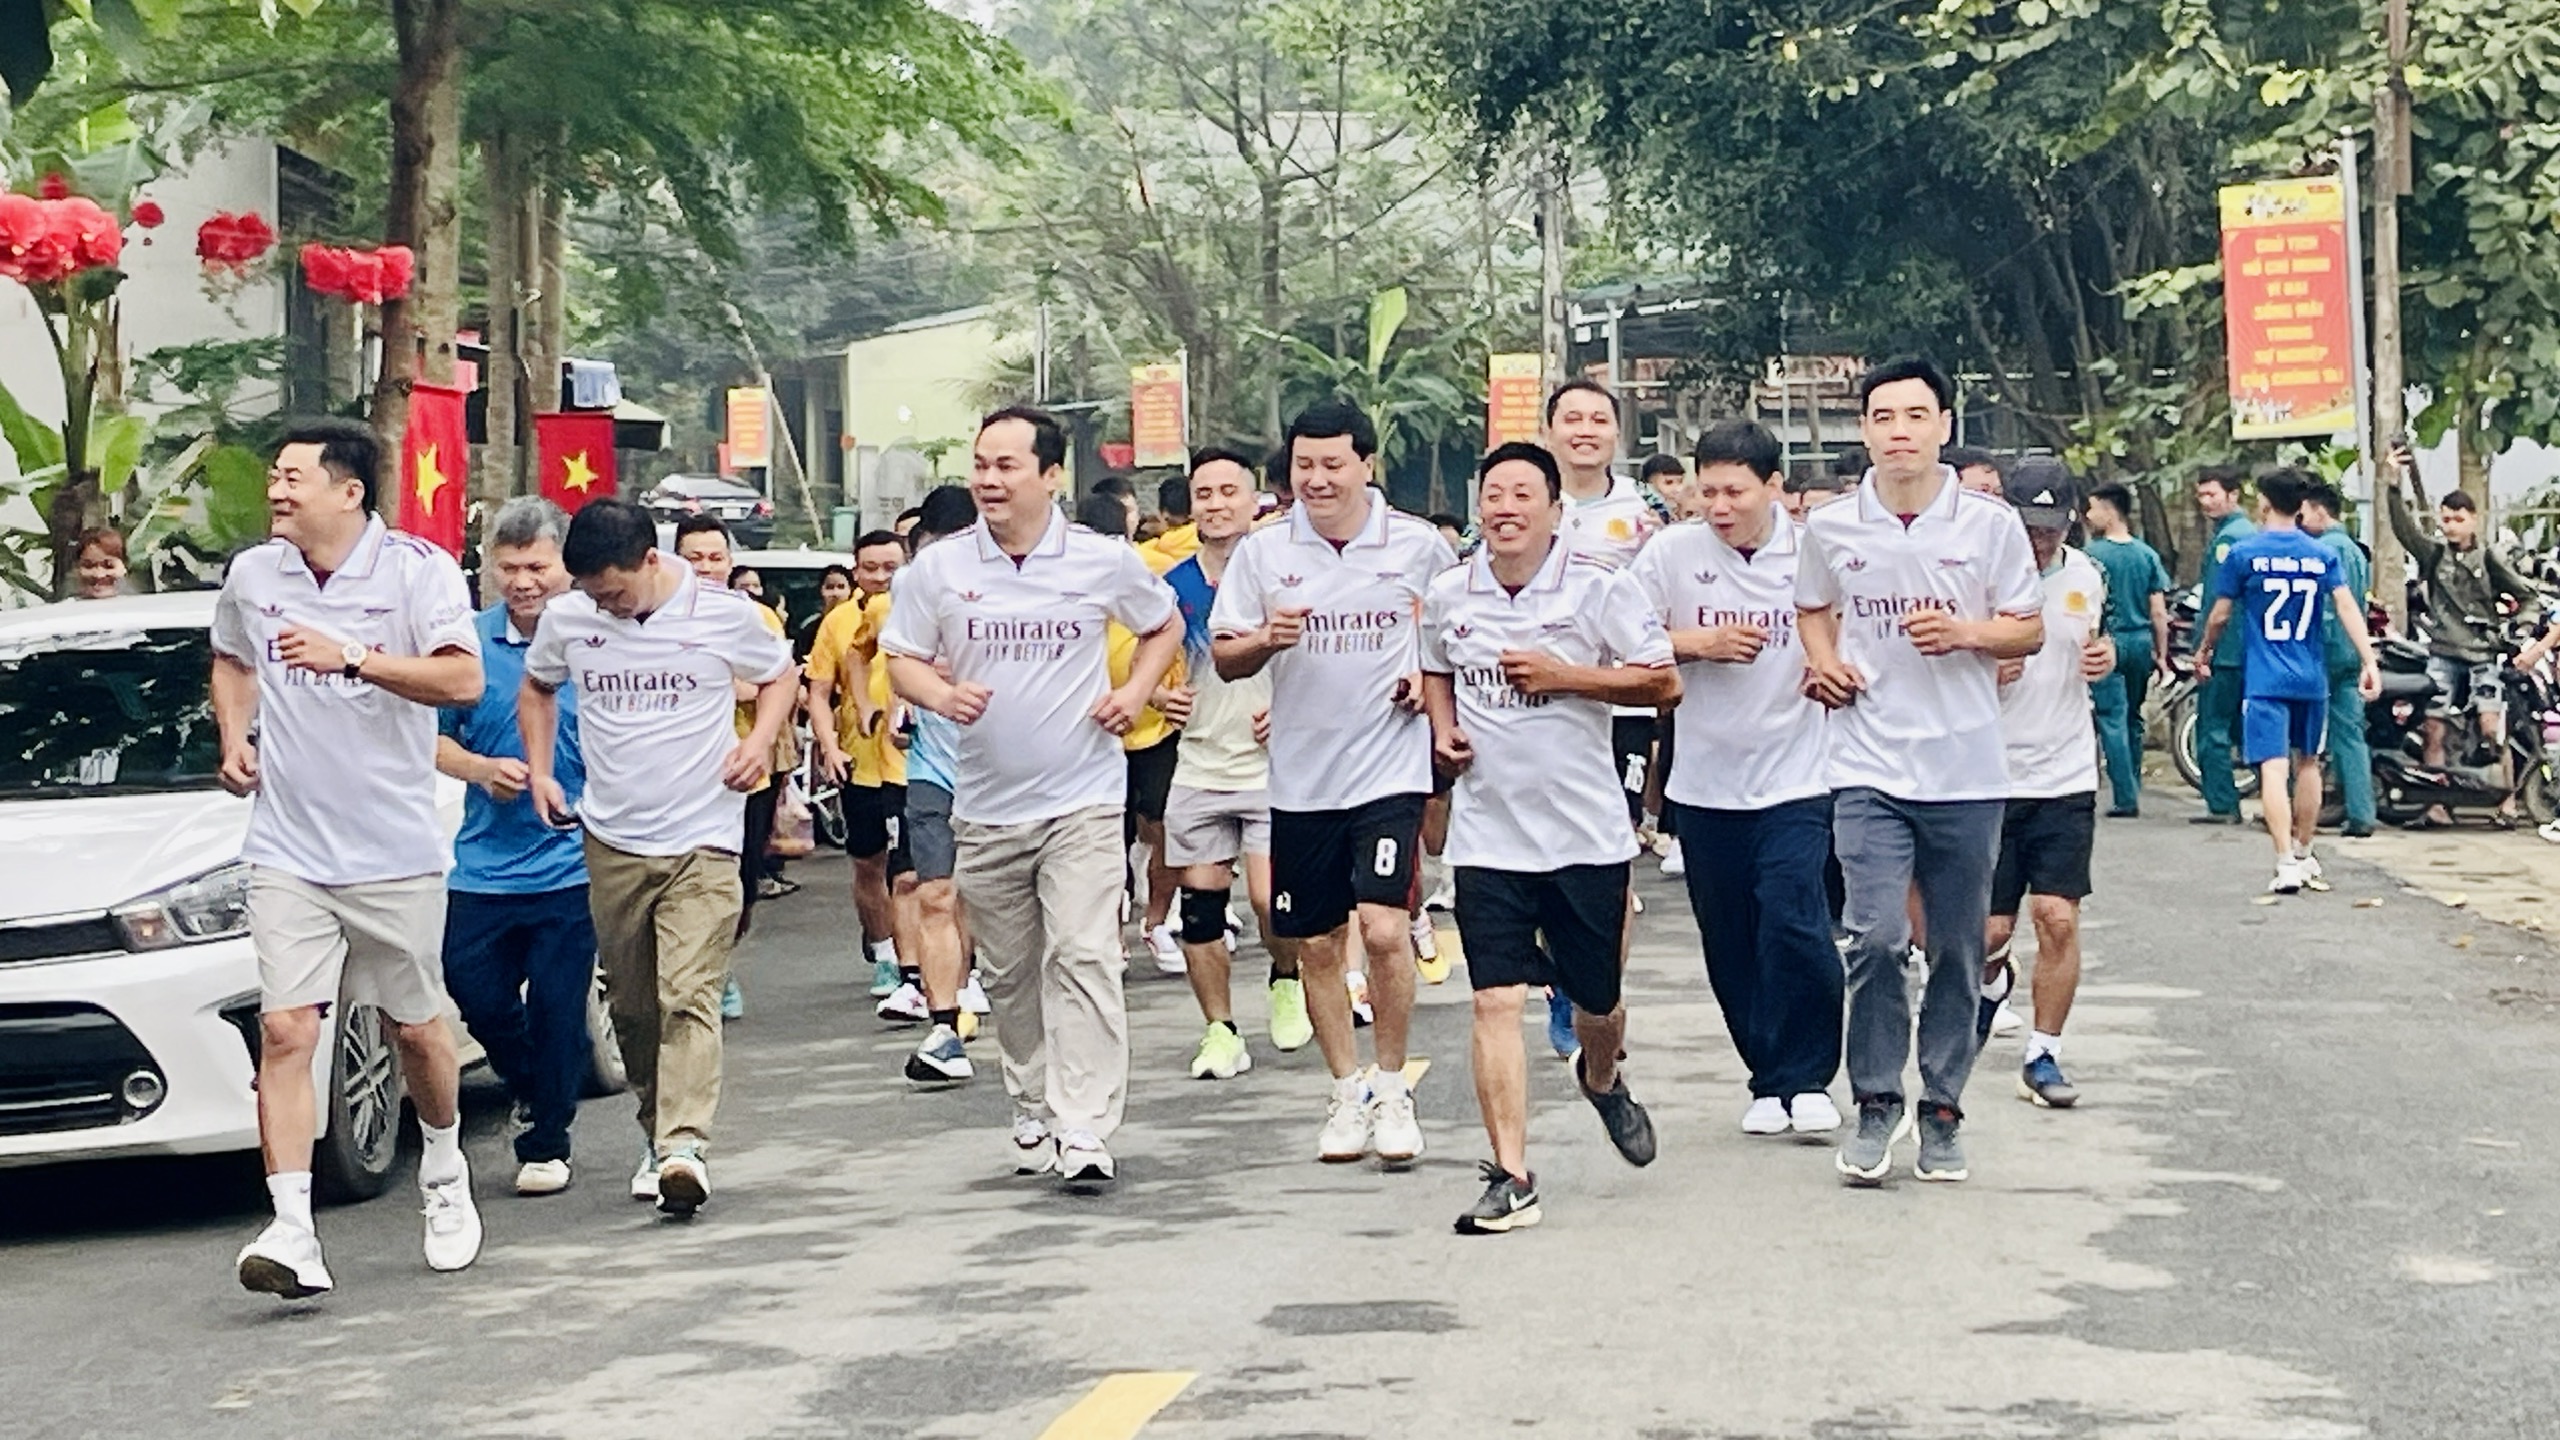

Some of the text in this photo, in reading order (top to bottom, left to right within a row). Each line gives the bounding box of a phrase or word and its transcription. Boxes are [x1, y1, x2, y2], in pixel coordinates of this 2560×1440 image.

[1304, 609, 1398, 632] mirates
[1698, 605, 1795, 628] Emirate
[2263, 578, 2318, 641] 27
[967, 617, 1082, 641] Emirates
[985, 643, 1065, 661] FLY BETTER
[1307, 632, 1384, 654] FLY BETTER
[582, 669, 698, 692] Emirates
[1374, 838, 1398, 876] 8
